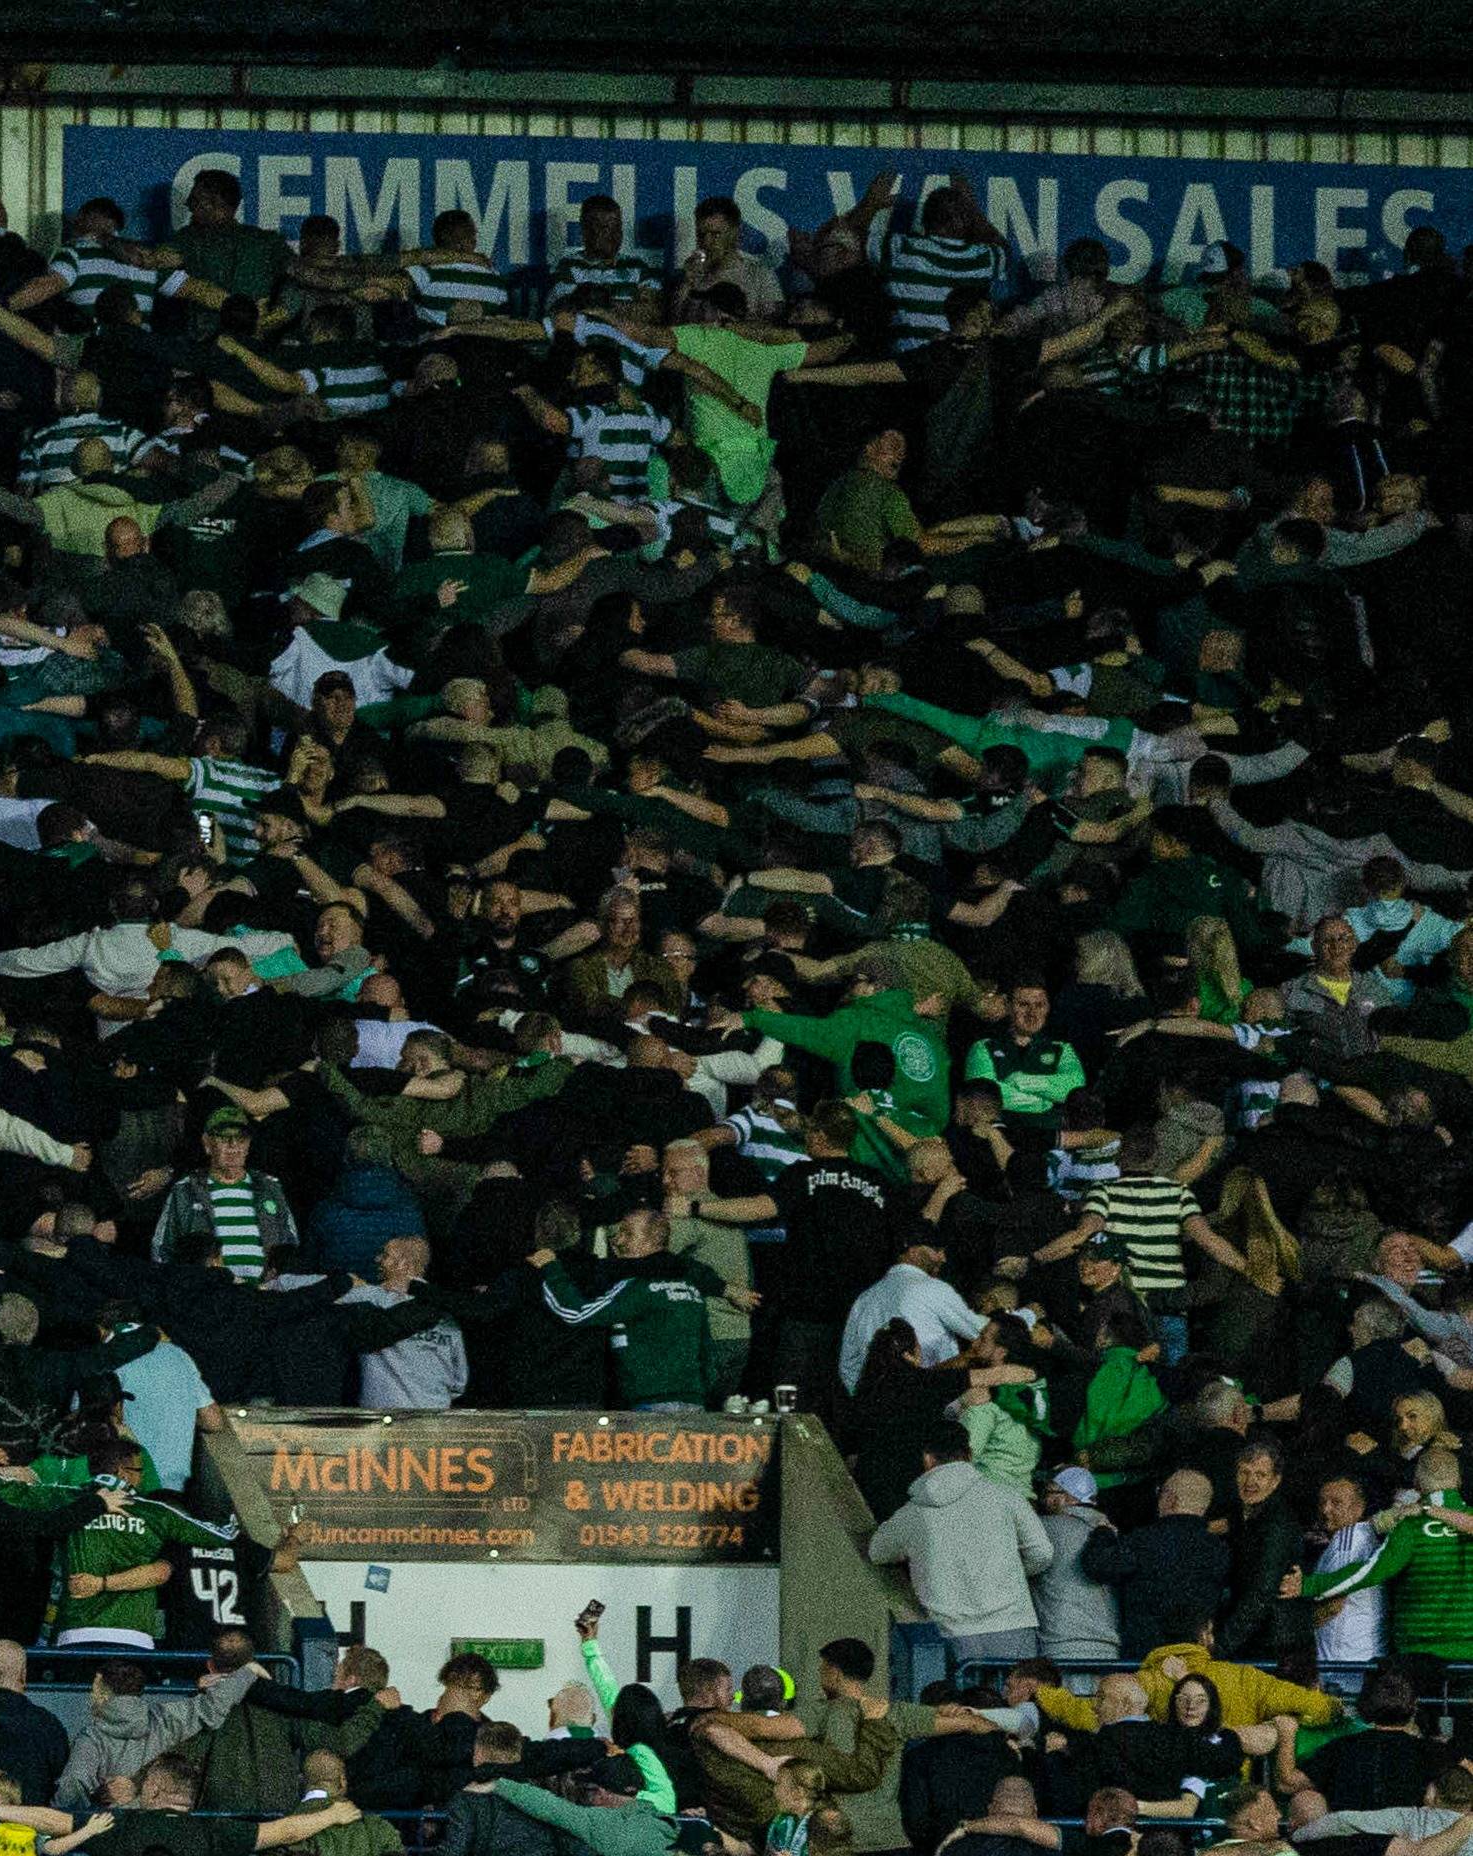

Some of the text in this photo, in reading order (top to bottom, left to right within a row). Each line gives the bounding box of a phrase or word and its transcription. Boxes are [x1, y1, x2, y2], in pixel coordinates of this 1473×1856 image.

[552, 1432, 770, 1465] FABRICATION
[270, 1446, 494, 1495] McINNES
[564, 1480, 760, 1514] & WELDING
[578, 1525, 745, 1549] 01563 522774
[190, 1568, 246, 1626] 42
[636, 1607, 691, 1682] H
